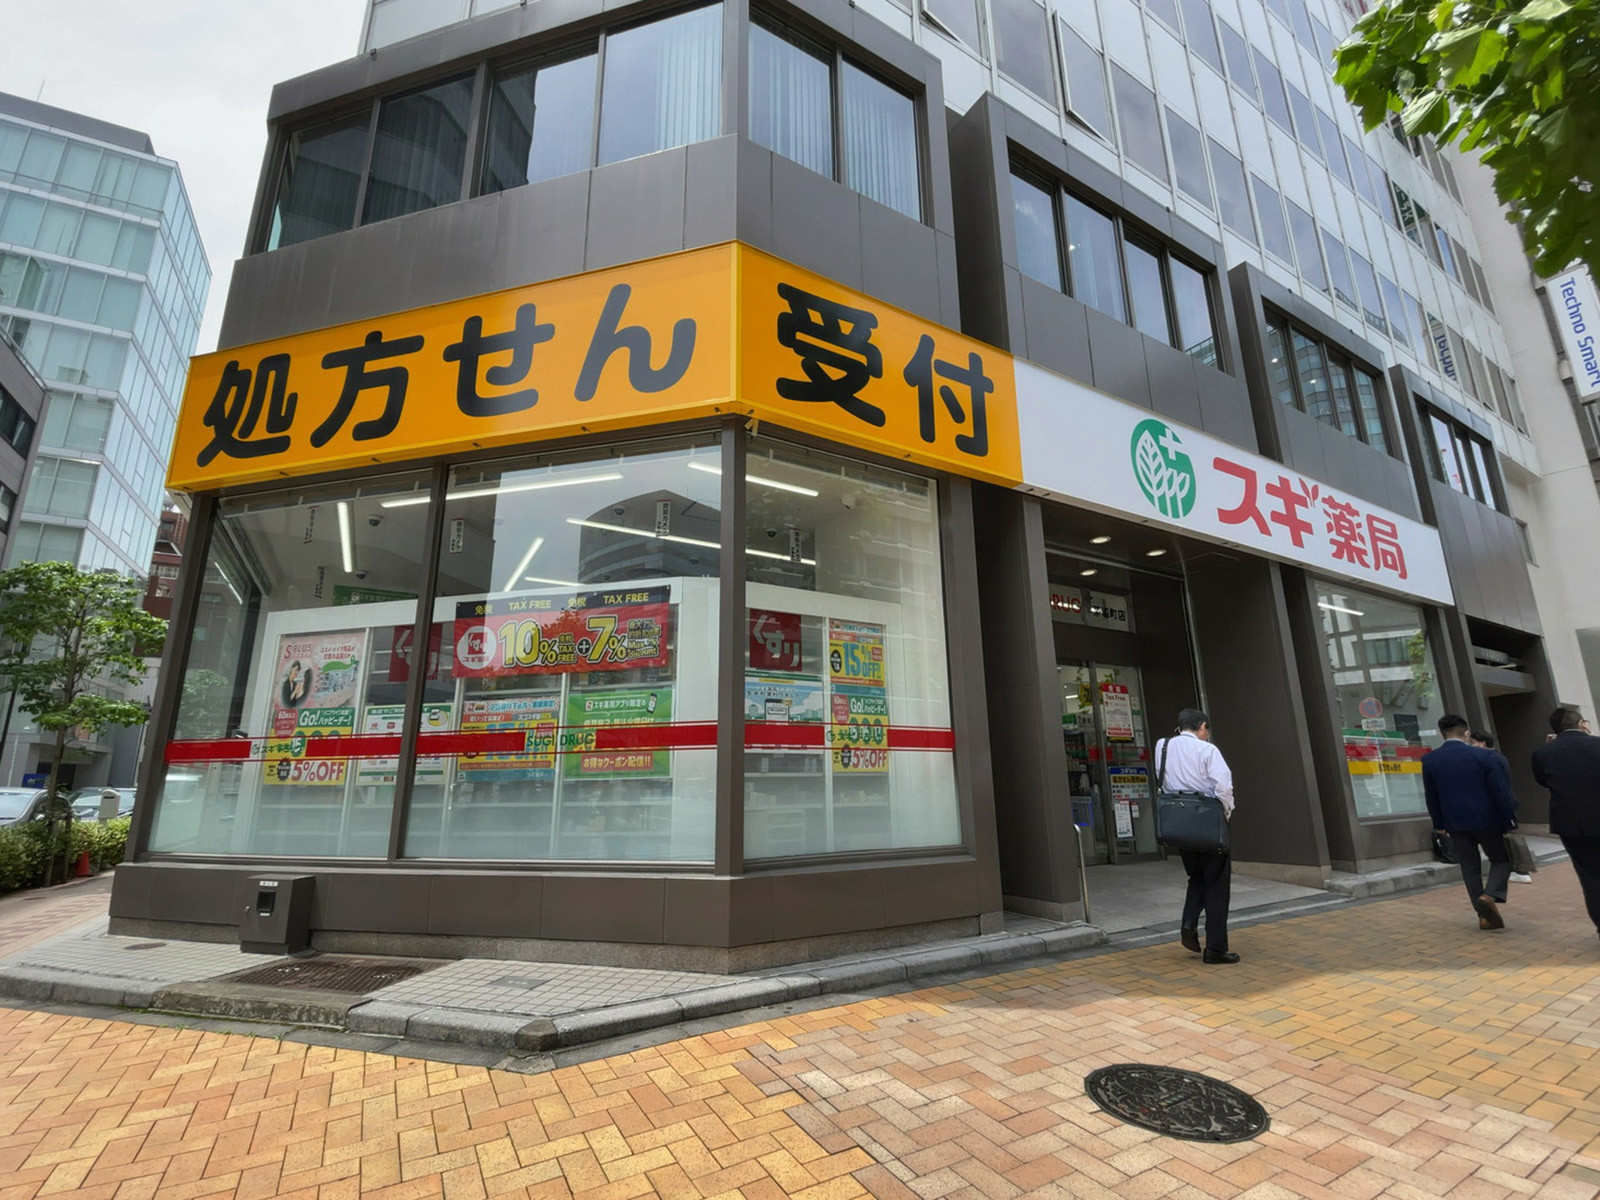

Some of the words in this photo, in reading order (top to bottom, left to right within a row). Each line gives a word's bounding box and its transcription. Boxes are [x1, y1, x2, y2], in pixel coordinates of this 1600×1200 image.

[1560, 277, 1586, 334] Techno
[1578, 336, 1600, 388] Smart
[196, 283, 698, 468] 処方せん
[775, 281, 995, 458] 受付
[1211, 456, 1408, 580] スギ薬局
[508, 600, 527, 611] TAX
[528, 599, 552, 609] FREE
[603, 594, 623, 605] TAX
[625, 592, 650, 603] FREE
[1049, 593, 1081, 614] RUG
[499, 620, 557, 665] 10%
[558, 644, 574, 653] TAX
[752, 614, 800, 667] くすり
[557, 653, 576, 662] FREE
[300, 710, 320, 726] Go!
[526, 734, 555, 748] SUGI
[559, 733, 594, 746] DRUG
